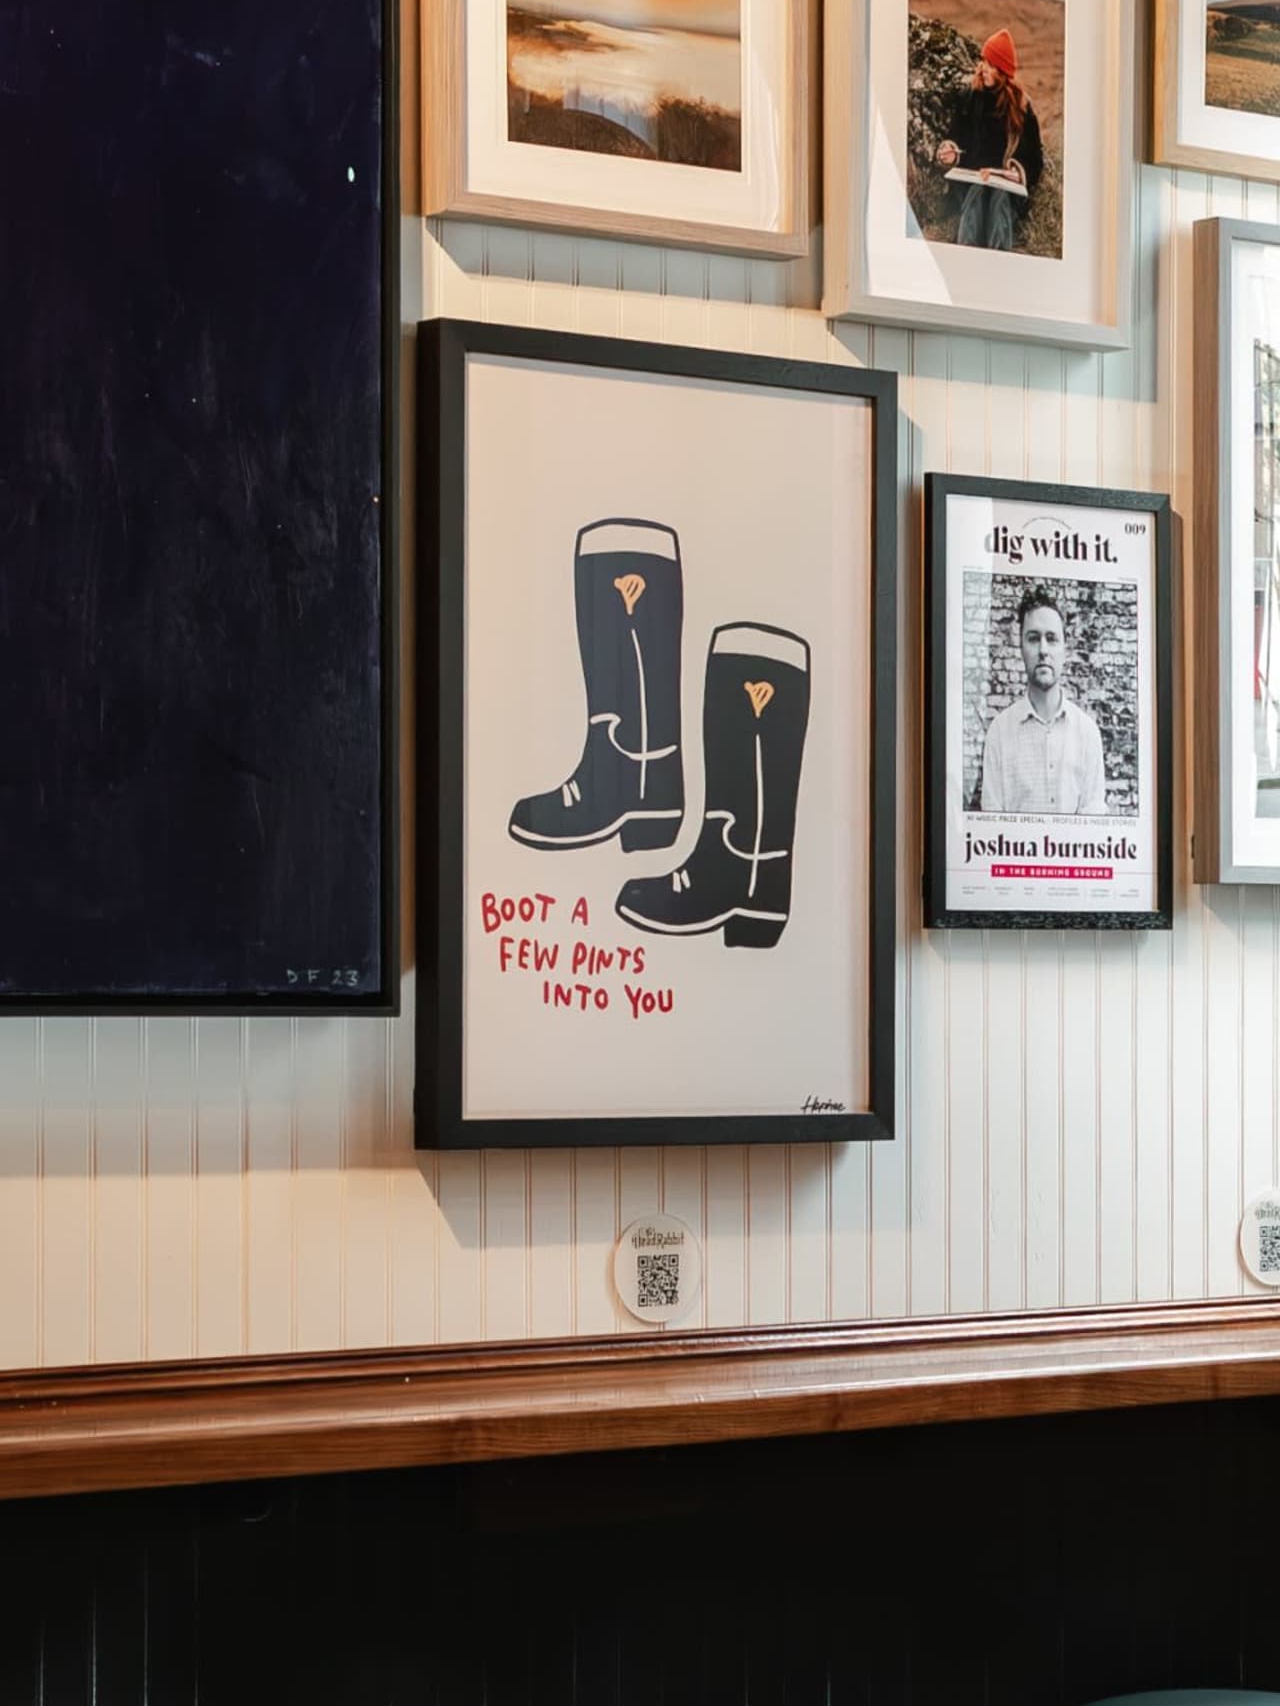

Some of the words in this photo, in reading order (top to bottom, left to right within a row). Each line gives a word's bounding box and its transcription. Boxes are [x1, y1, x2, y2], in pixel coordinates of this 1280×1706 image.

[984, 524, 1025, 565] dig
[1030, 530, 1088, 561] with
[1094, 533, 1119, 564] it.
[964, 831, 1038, 864] joshua
[1043, 834, 1138, 861] burnside
[1009, 867, 1026, 876] THE
[481, 892, 556, 933] BOOT
[571, 896, 590, 926] A
[499, 936, 559, 972] FEW
[571, 942, 646, 975] PINTS
[308, 969, 320, 984] F
[331, 969, 359, 987] 23
[543, 980, 609, 1011] INTO
[624, 983, 674, 1019] YOU
